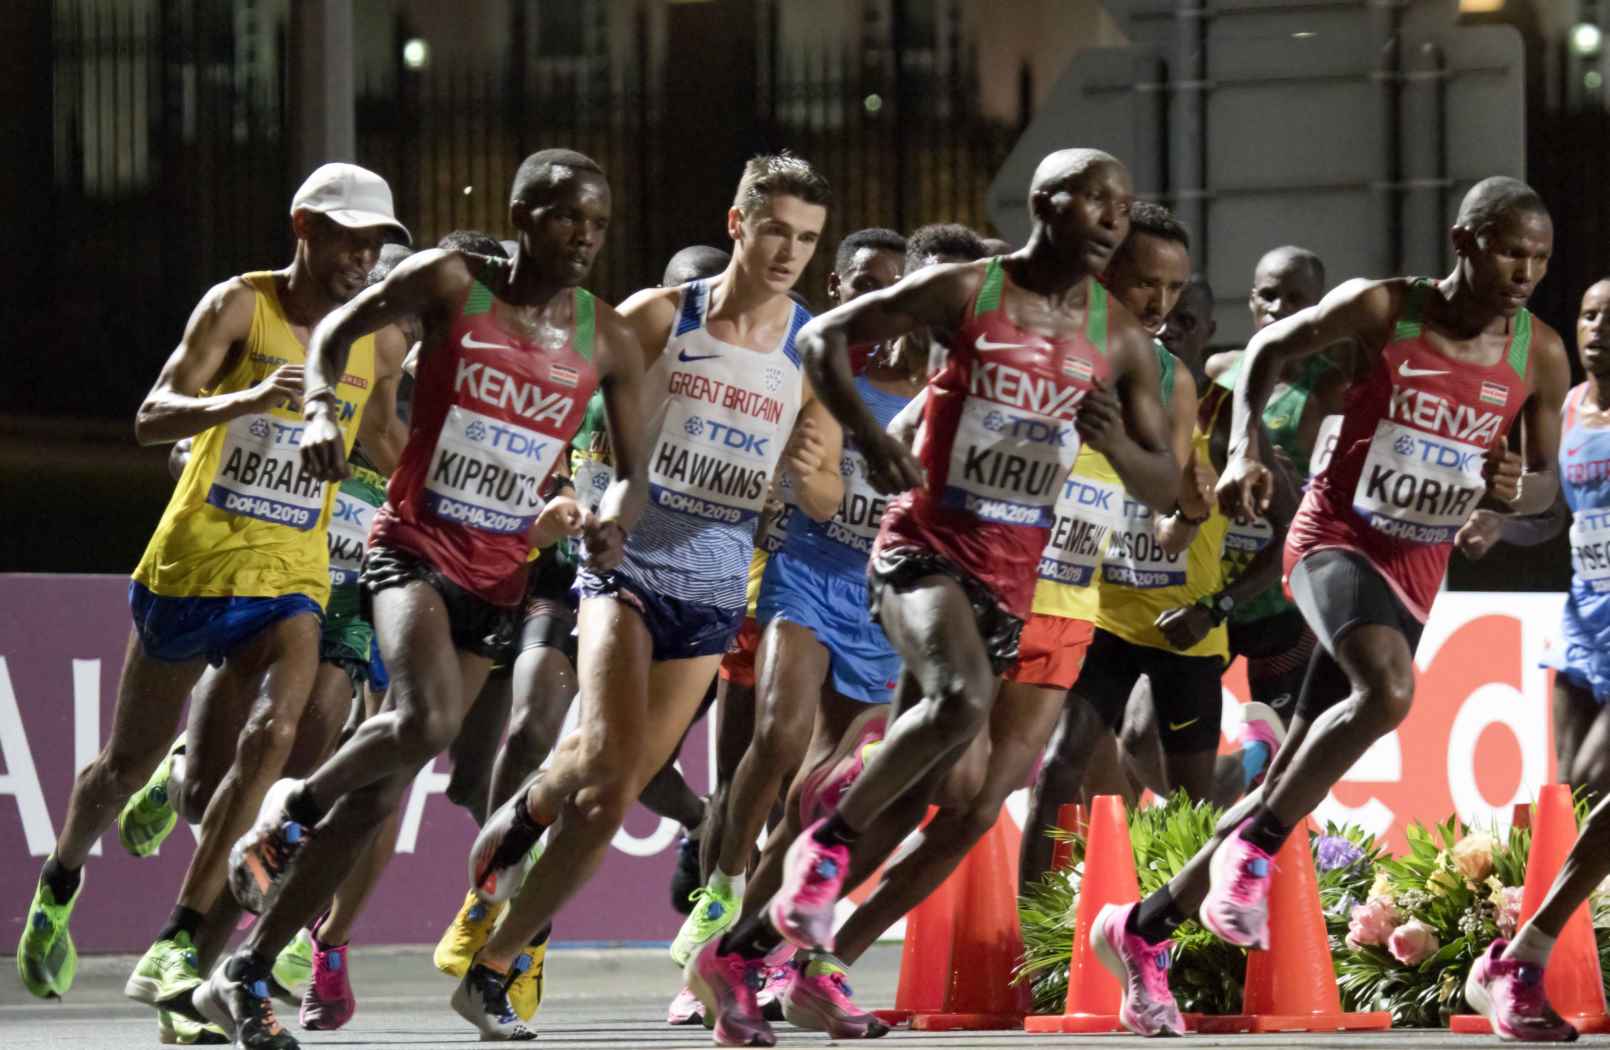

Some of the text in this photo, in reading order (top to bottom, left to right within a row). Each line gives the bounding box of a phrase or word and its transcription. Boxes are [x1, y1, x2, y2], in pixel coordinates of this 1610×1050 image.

[454, 357, 574, 429] KENYA
[668, 371, 784, 425] GREAT BRITAIN
[1008, 415, 1071, 448] TDK
[1388, 384, 1503, 445] KENYA
[489, 425, 549, 462] TDK
[706, 420, 769, 457] TDK
[1418, 439, 1477, 473] TDK
[655, 441, 767, 500] HAWKINS
[963, 445, 1061, 498] KIRUI
[659, 490, 742, 523] DOHA2019
[1064, 480, 1114, 511] TDK
[1366, 464, 1476, 516] KORIR
[225, 493, 309, 525] DOHA2019
[332, 498, 365, 527] DK
[438, 498, 522, 532] DOHA2019
[1052, 516, 1109, 557] EMEW
[1370, 514, 1452, 543] DOHA2019
